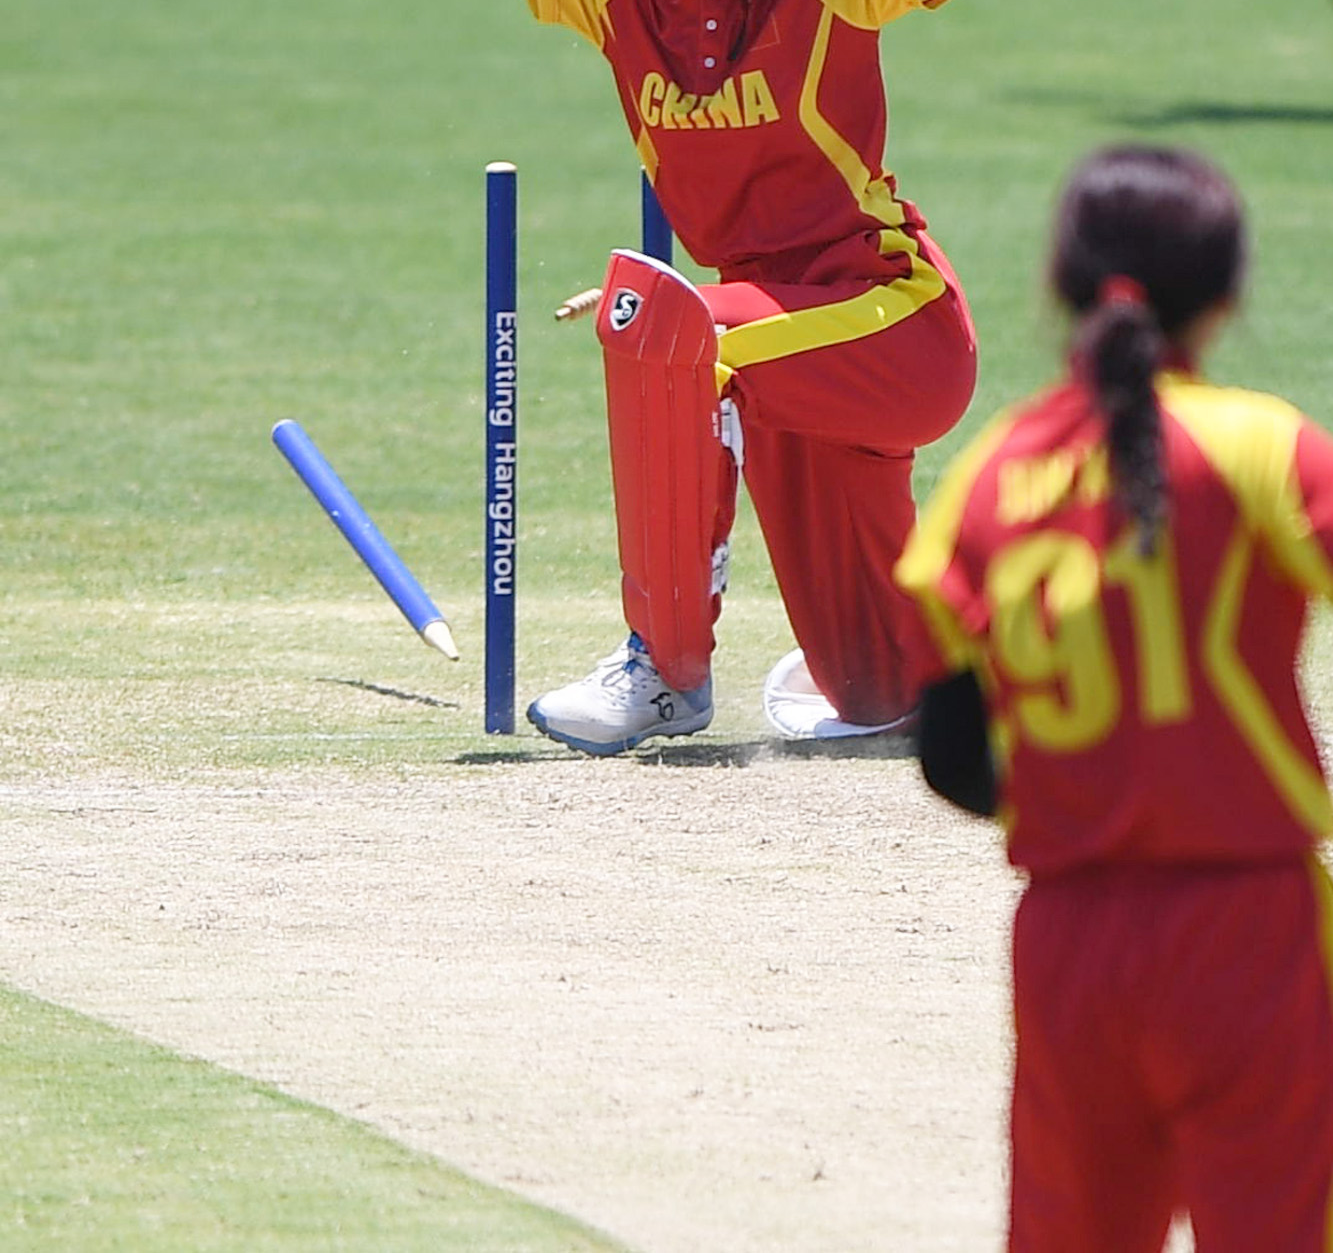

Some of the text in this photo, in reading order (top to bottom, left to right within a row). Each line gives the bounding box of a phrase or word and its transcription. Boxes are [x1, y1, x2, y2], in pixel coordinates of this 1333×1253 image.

[640, 70, 780, 129] CHINA
[489, 311, 517, 595] Exciting Hangzhou
[986, 526, 1190, 752] 91
